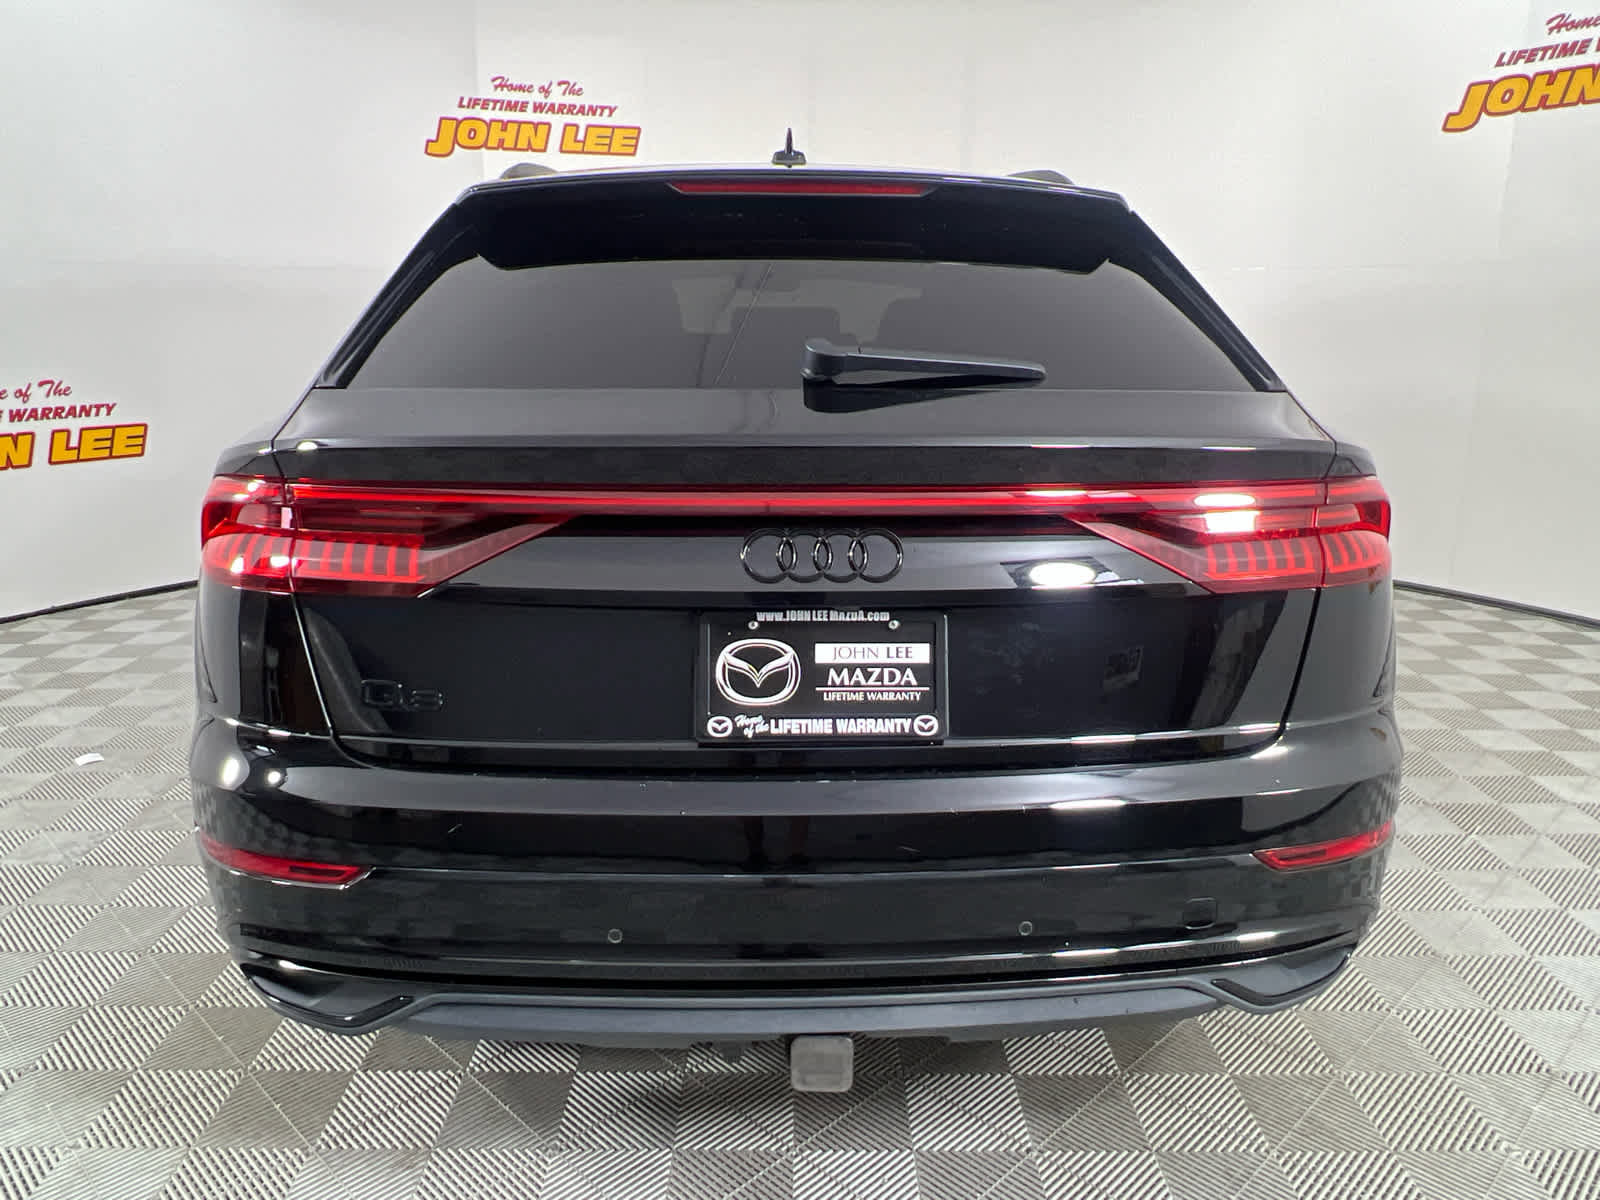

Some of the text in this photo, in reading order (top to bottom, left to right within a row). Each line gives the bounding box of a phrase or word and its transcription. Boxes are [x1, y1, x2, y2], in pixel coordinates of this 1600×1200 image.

[1546, 13, 1600, 35] Home
[1494, 37, 1593, 68] LIFETIME
[491, 76, 584, 99] Home of The
[1442, 63, 1600, 133] JOHN
[457, 96, 618, 117] LIFETIME WARRANTY
[424, 116, 642, 158] JOHN LEE
[14, 382, 32, 404] of
[37, 379, 73, 398] The
[8, 402, 117, 423] WARRANTY
[48, 423, 148, 466] LEE
[833, 645, 914, 661] JOHN LEE
[827, 667, 918, 686] MAZDA
[823, 691, 921, 701] LIFETIME WARRANTY
[770, 718, 912, 734] LIFETIME WARRANTY
